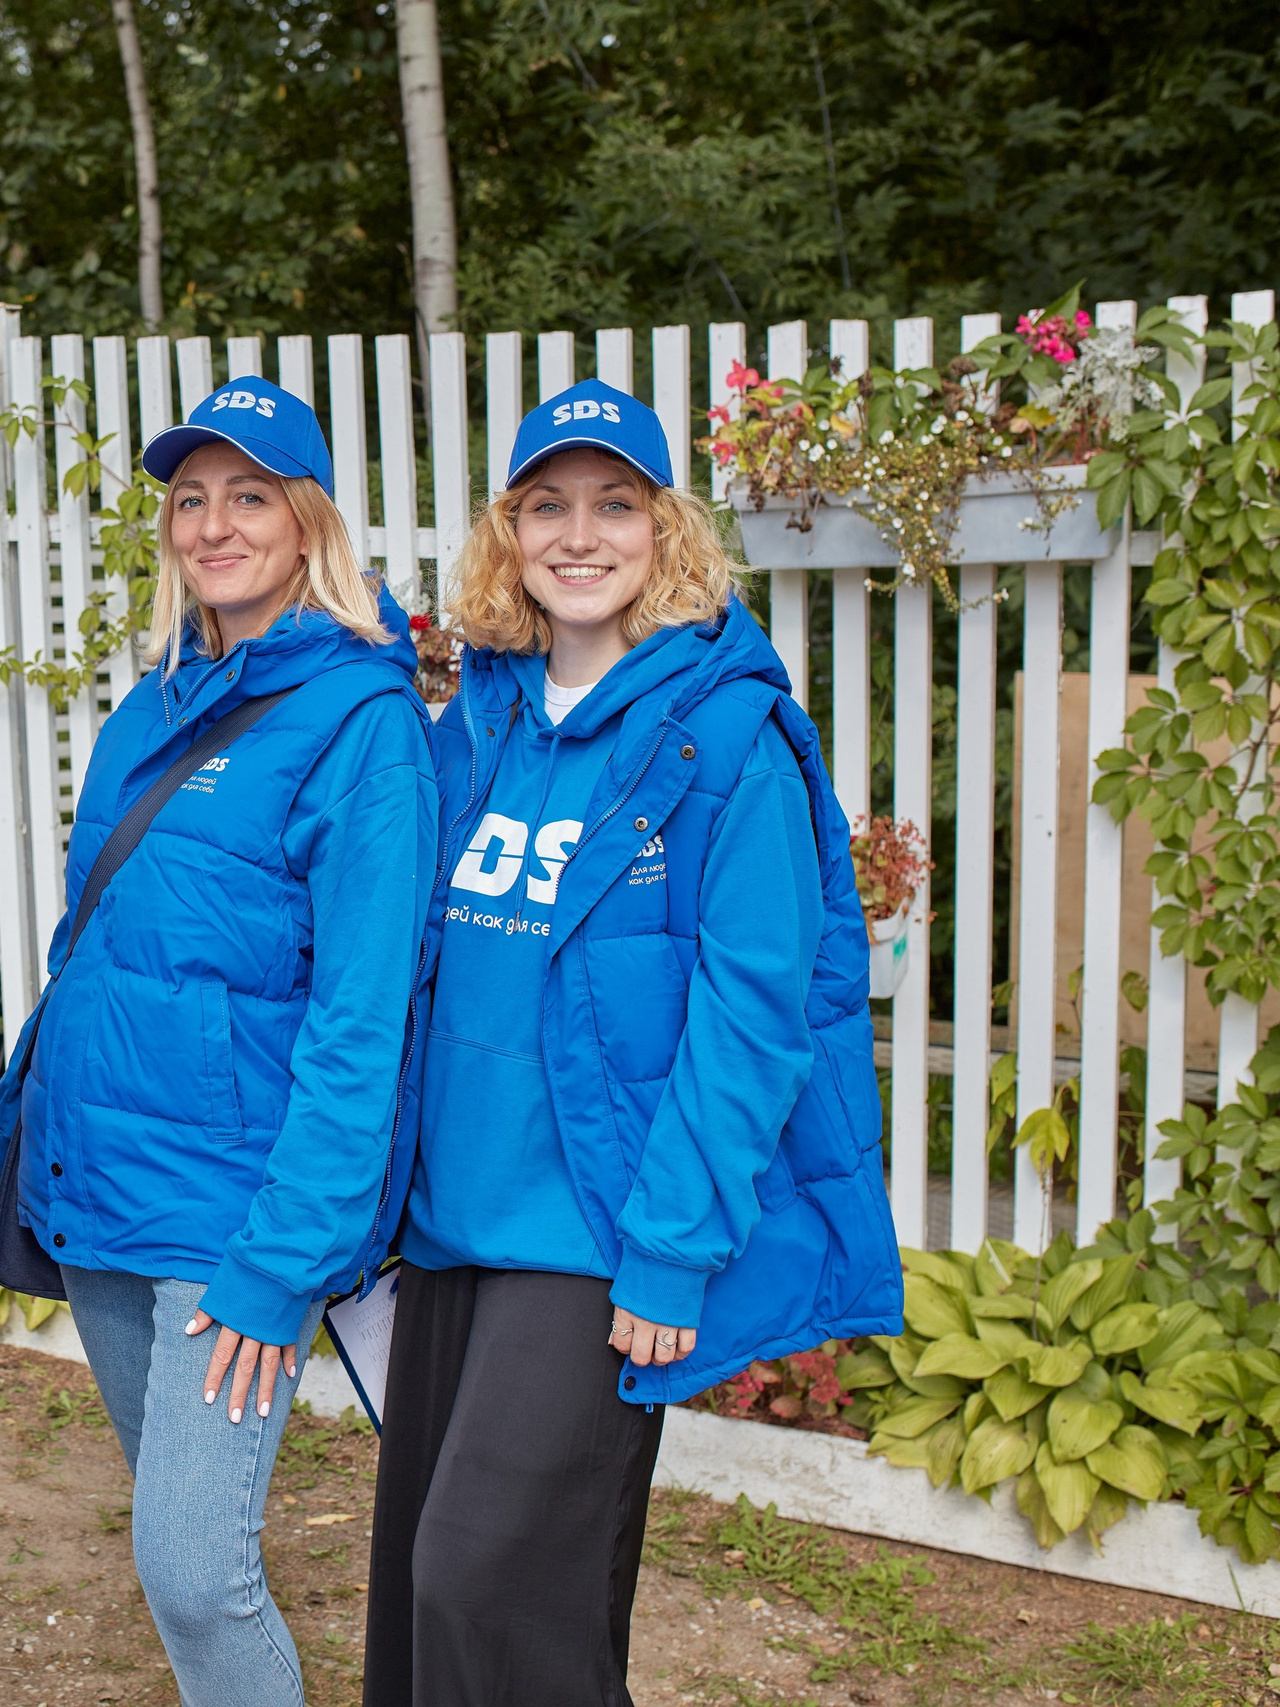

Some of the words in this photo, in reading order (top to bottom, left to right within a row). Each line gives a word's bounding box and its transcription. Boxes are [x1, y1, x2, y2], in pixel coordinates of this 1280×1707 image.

[212, 391, 276, 418] SDS
[553, 400, 621, 426] SDS
[198, 757, 230, 772] DS
[197, 776, 217, 785] людей
[188, 783, 199, 791] для
[199, 785, 215, 794] себя
[635, 834, 665, 858] DS
[630, 866, 648, 877] Для
[628, 878, 644, 886] как
[645, 875, 659, 885] для
[472, 912, 504, 930] как
